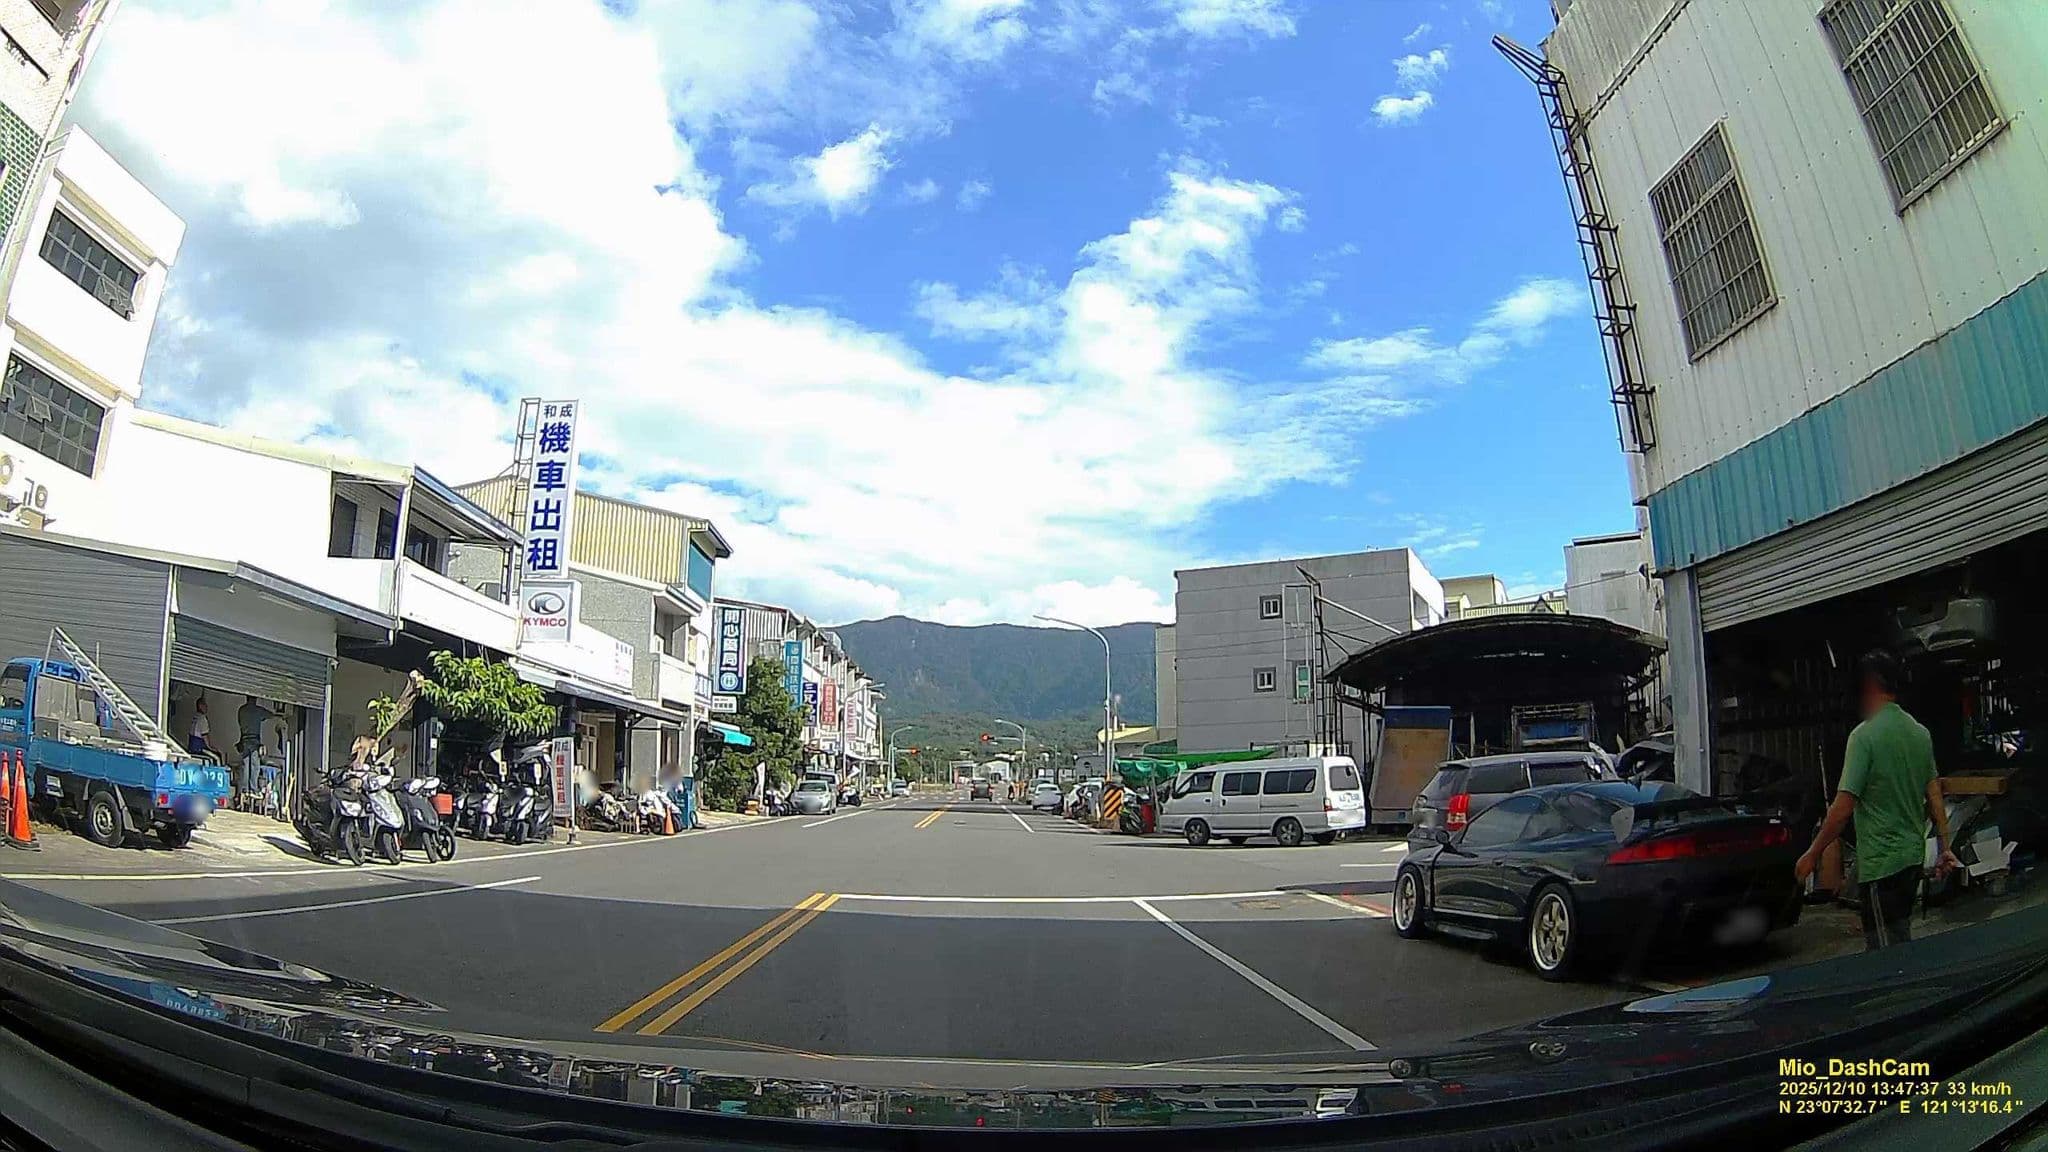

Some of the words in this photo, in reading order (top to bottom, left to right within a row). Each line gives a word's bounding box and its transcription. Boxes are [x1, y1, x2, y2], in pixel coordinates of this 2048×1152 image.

[544, 404, 573, 418] 和成
[527, 422, 571, 571] 機車出租
[523, 617, 567, 627] KYMCO
